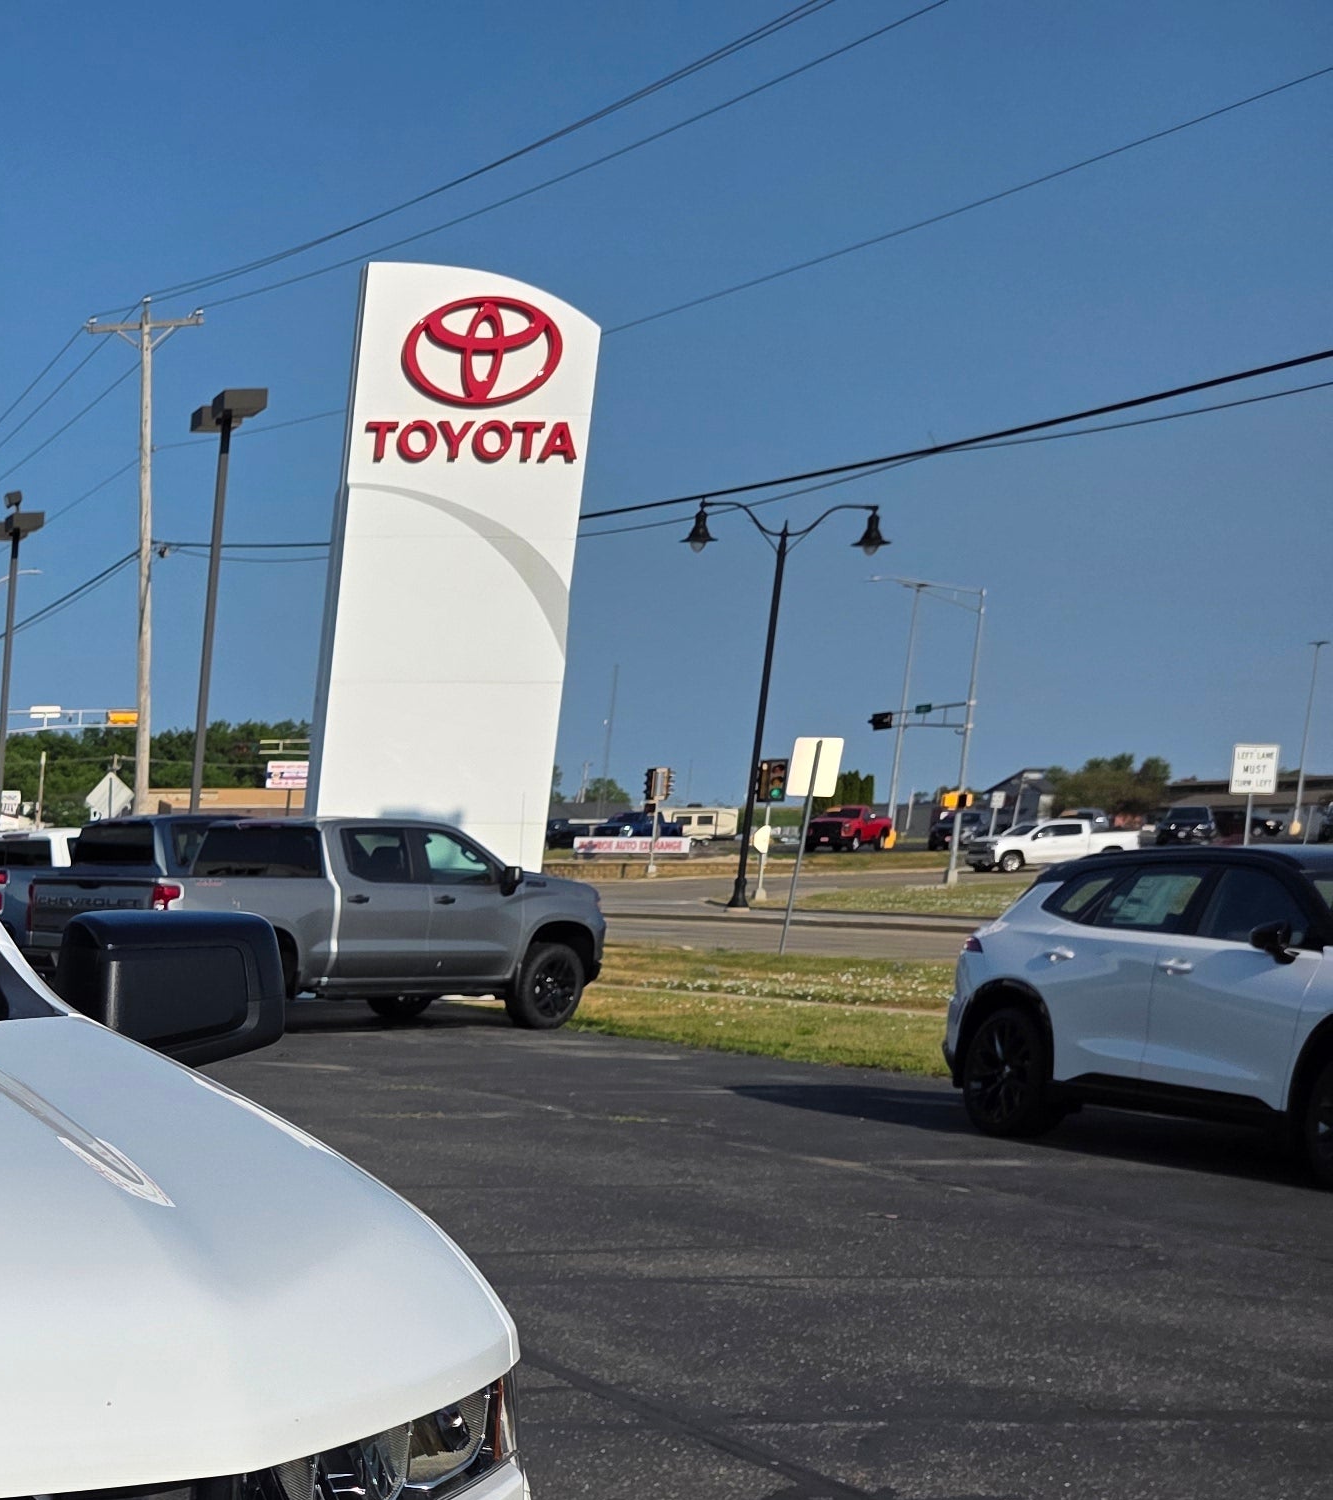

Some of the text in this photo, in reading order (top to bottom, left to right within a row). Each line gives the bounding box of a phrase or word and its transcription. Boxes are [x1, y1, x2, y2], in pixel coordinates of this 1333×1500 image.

[365, 419, 577, 463] TOYOTA
[1237, 751, 1253, 760] LEFT
[1243, 764, 1267, 774] MUST
[639, 840, 682, 851] EXHANGE
[36, 895, 141, 909] CHEVROLET
